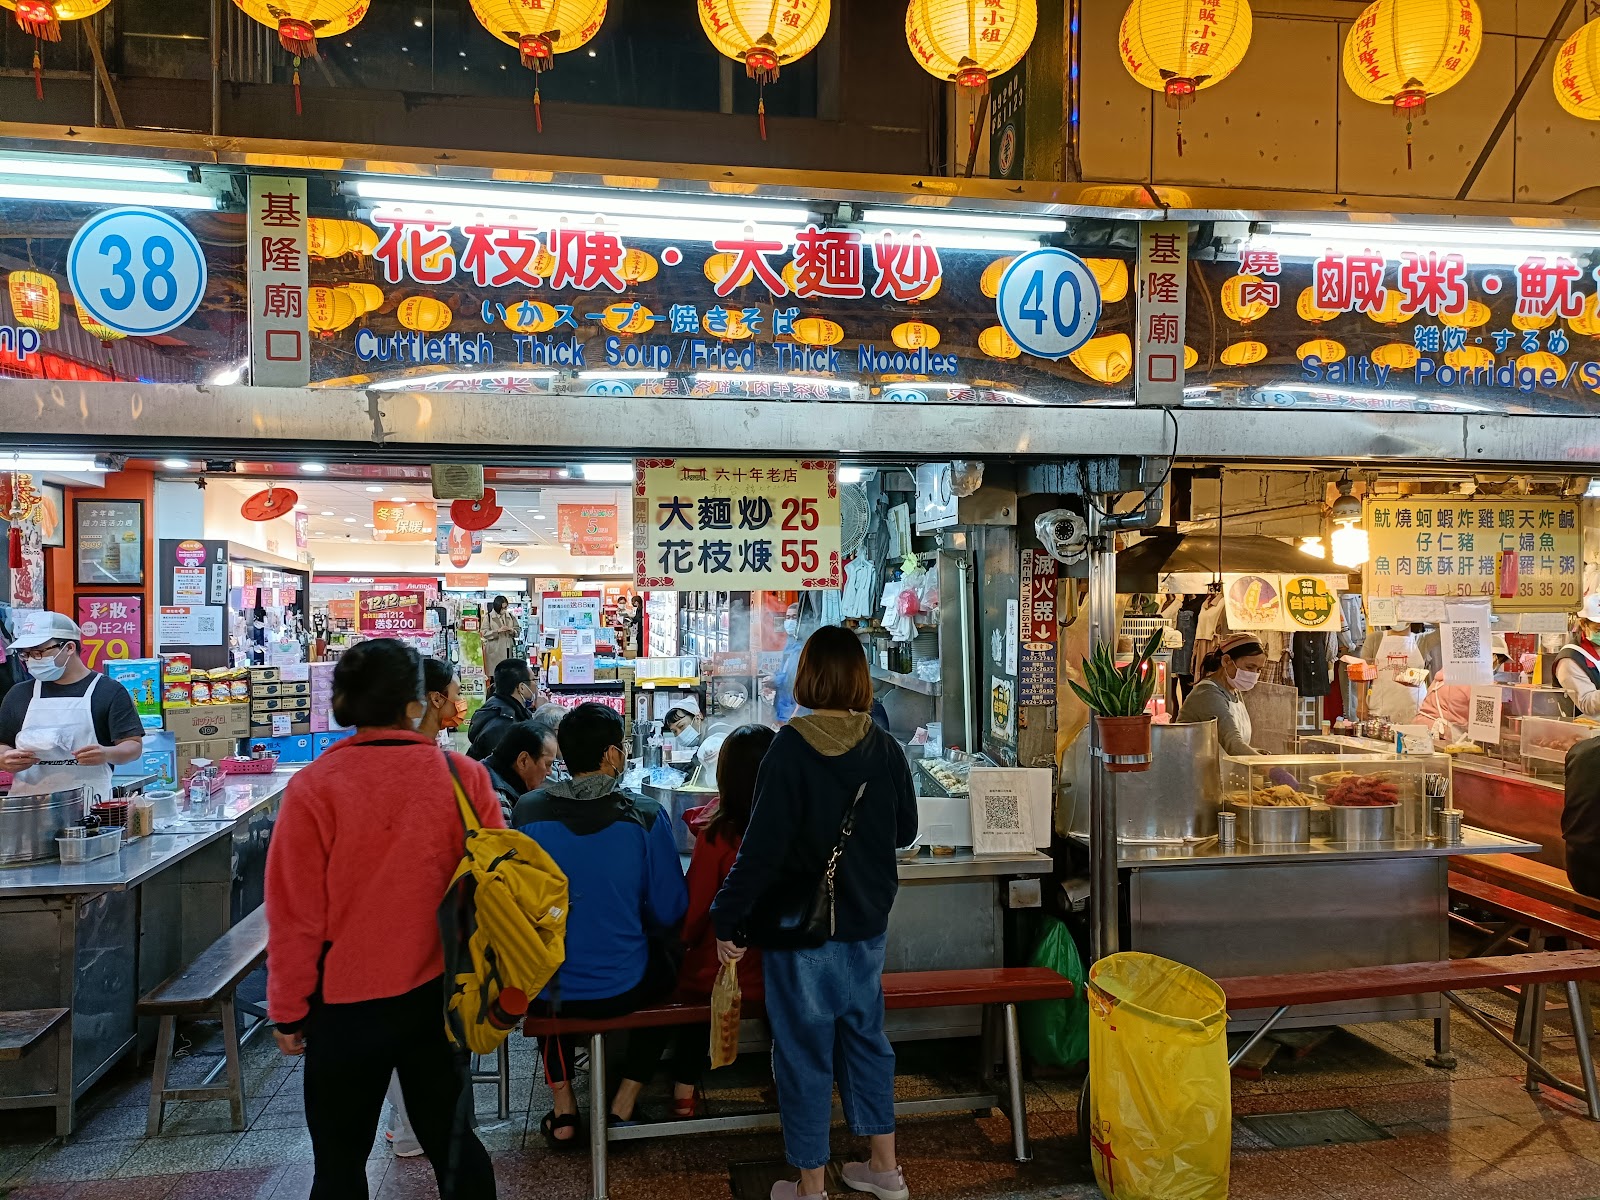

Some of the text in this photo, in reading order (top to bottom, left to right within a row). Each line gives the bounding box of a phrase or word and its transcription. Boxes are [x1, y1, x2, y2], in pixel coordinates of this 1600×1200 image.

[98, 233, 178, 312] 38
[261, 192, 302, 362] 基隆廟口
[1019, 269, 1082, 338] 40
[1147, 233, 1181, 383] 基隆廟口
[355, 328, 494, 364] Cuttlefish
[512, 334, 584, 365] Thick
[773, 343, 841, 373] Thick
[858, 344, 958, 375] Noodles
[1302, 355, 1391, 387] Salty
[715, 468, 798, 483] 六十年老店
[658, 495, 819, 531] 大麵炒 25
[781, 539, 819, 573] 55
[1034, 553, 1055, 622] 滅火器
[1457, 583, 1472, 596] 50
[1480, 581, 1494, 595] 40
[1520, 582, 1533, 596] 35
[1539, 582, 1553, 596] 35
[1560, 582, 1574, 597] 20
[99, 622, 136, 635] 任2件
[82, 638, 129, 669] 79
